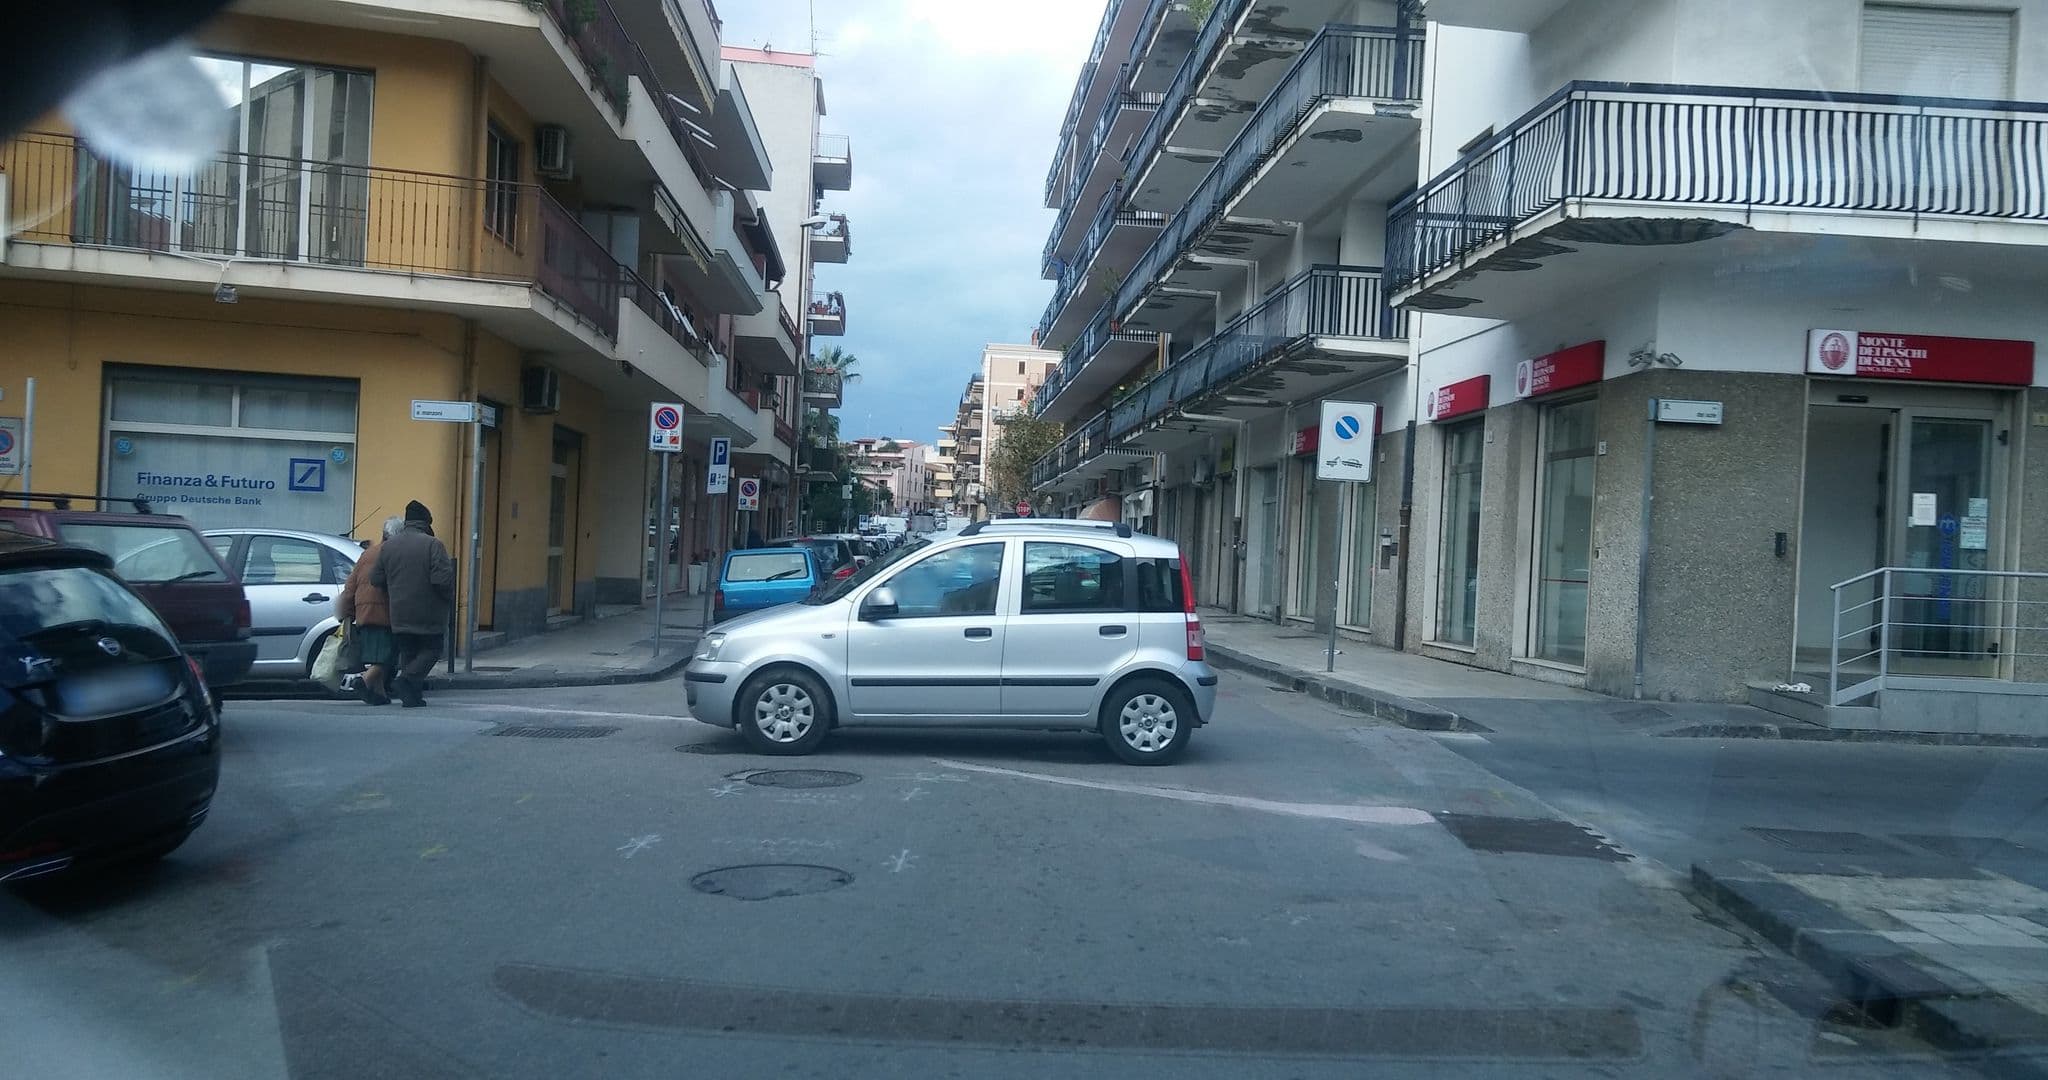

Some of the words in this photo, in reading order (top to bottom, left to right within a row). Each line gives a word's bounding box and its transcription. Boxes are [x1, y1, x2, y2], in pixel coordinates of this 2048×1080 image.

[1859, 336, 1905, 348] MONTE
[1859, 346, 1881, 357] DEI
[1882, 347, 1927, 359] PASCHI
[1858, 356, 1873, 366] DI
[1873, 357, 1912, 368] SIENA
[136, 471, 202, 487] Finanza
[204, 474, 218, 488] &
[221, 475, 275, 490] Futuro
[137, 492, 177, 504] Gruppo
[180, 494, 231, 505] Deutsche
[234, 496, 262, 506] Bank
